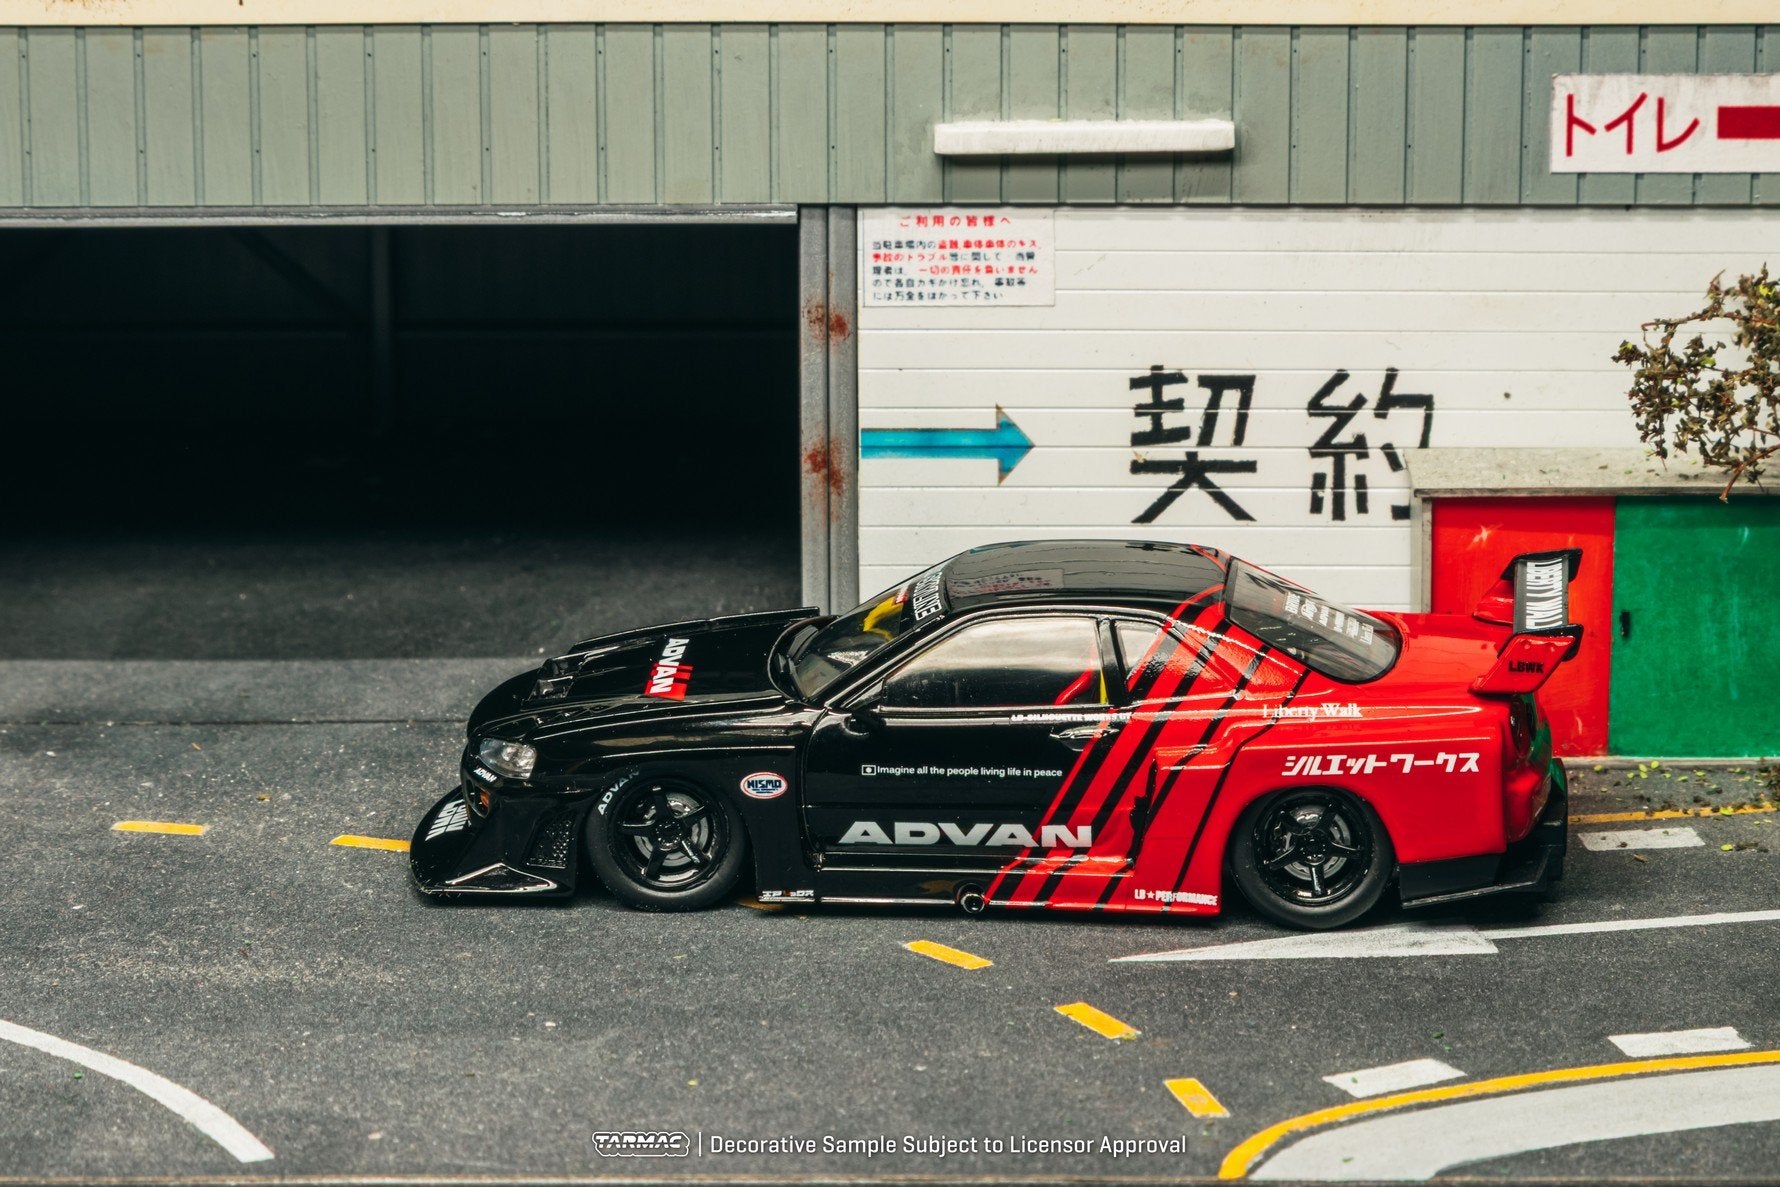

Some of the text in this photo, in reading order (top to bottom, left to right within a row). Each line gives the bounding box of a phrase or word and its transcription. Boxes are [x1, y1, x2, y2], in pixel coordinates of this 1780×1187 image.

[1565, 92, 1700, 157] トイレ
[899, 214, 1012, 228] ご利用の皆様へ
[650, 638, 690, 694] ADVAN
[1508, 660, 1544, 673] LBWK
[1321, 702, 1363, 718] Walk
[877, 766, 1063, 778] Imagine all the people living life in peace
[1281, 752, 1480, 776] シルエットワークス
[598, 768, 640, 816] ADVAN
[838, 821, 1092, 848] ADVAN
